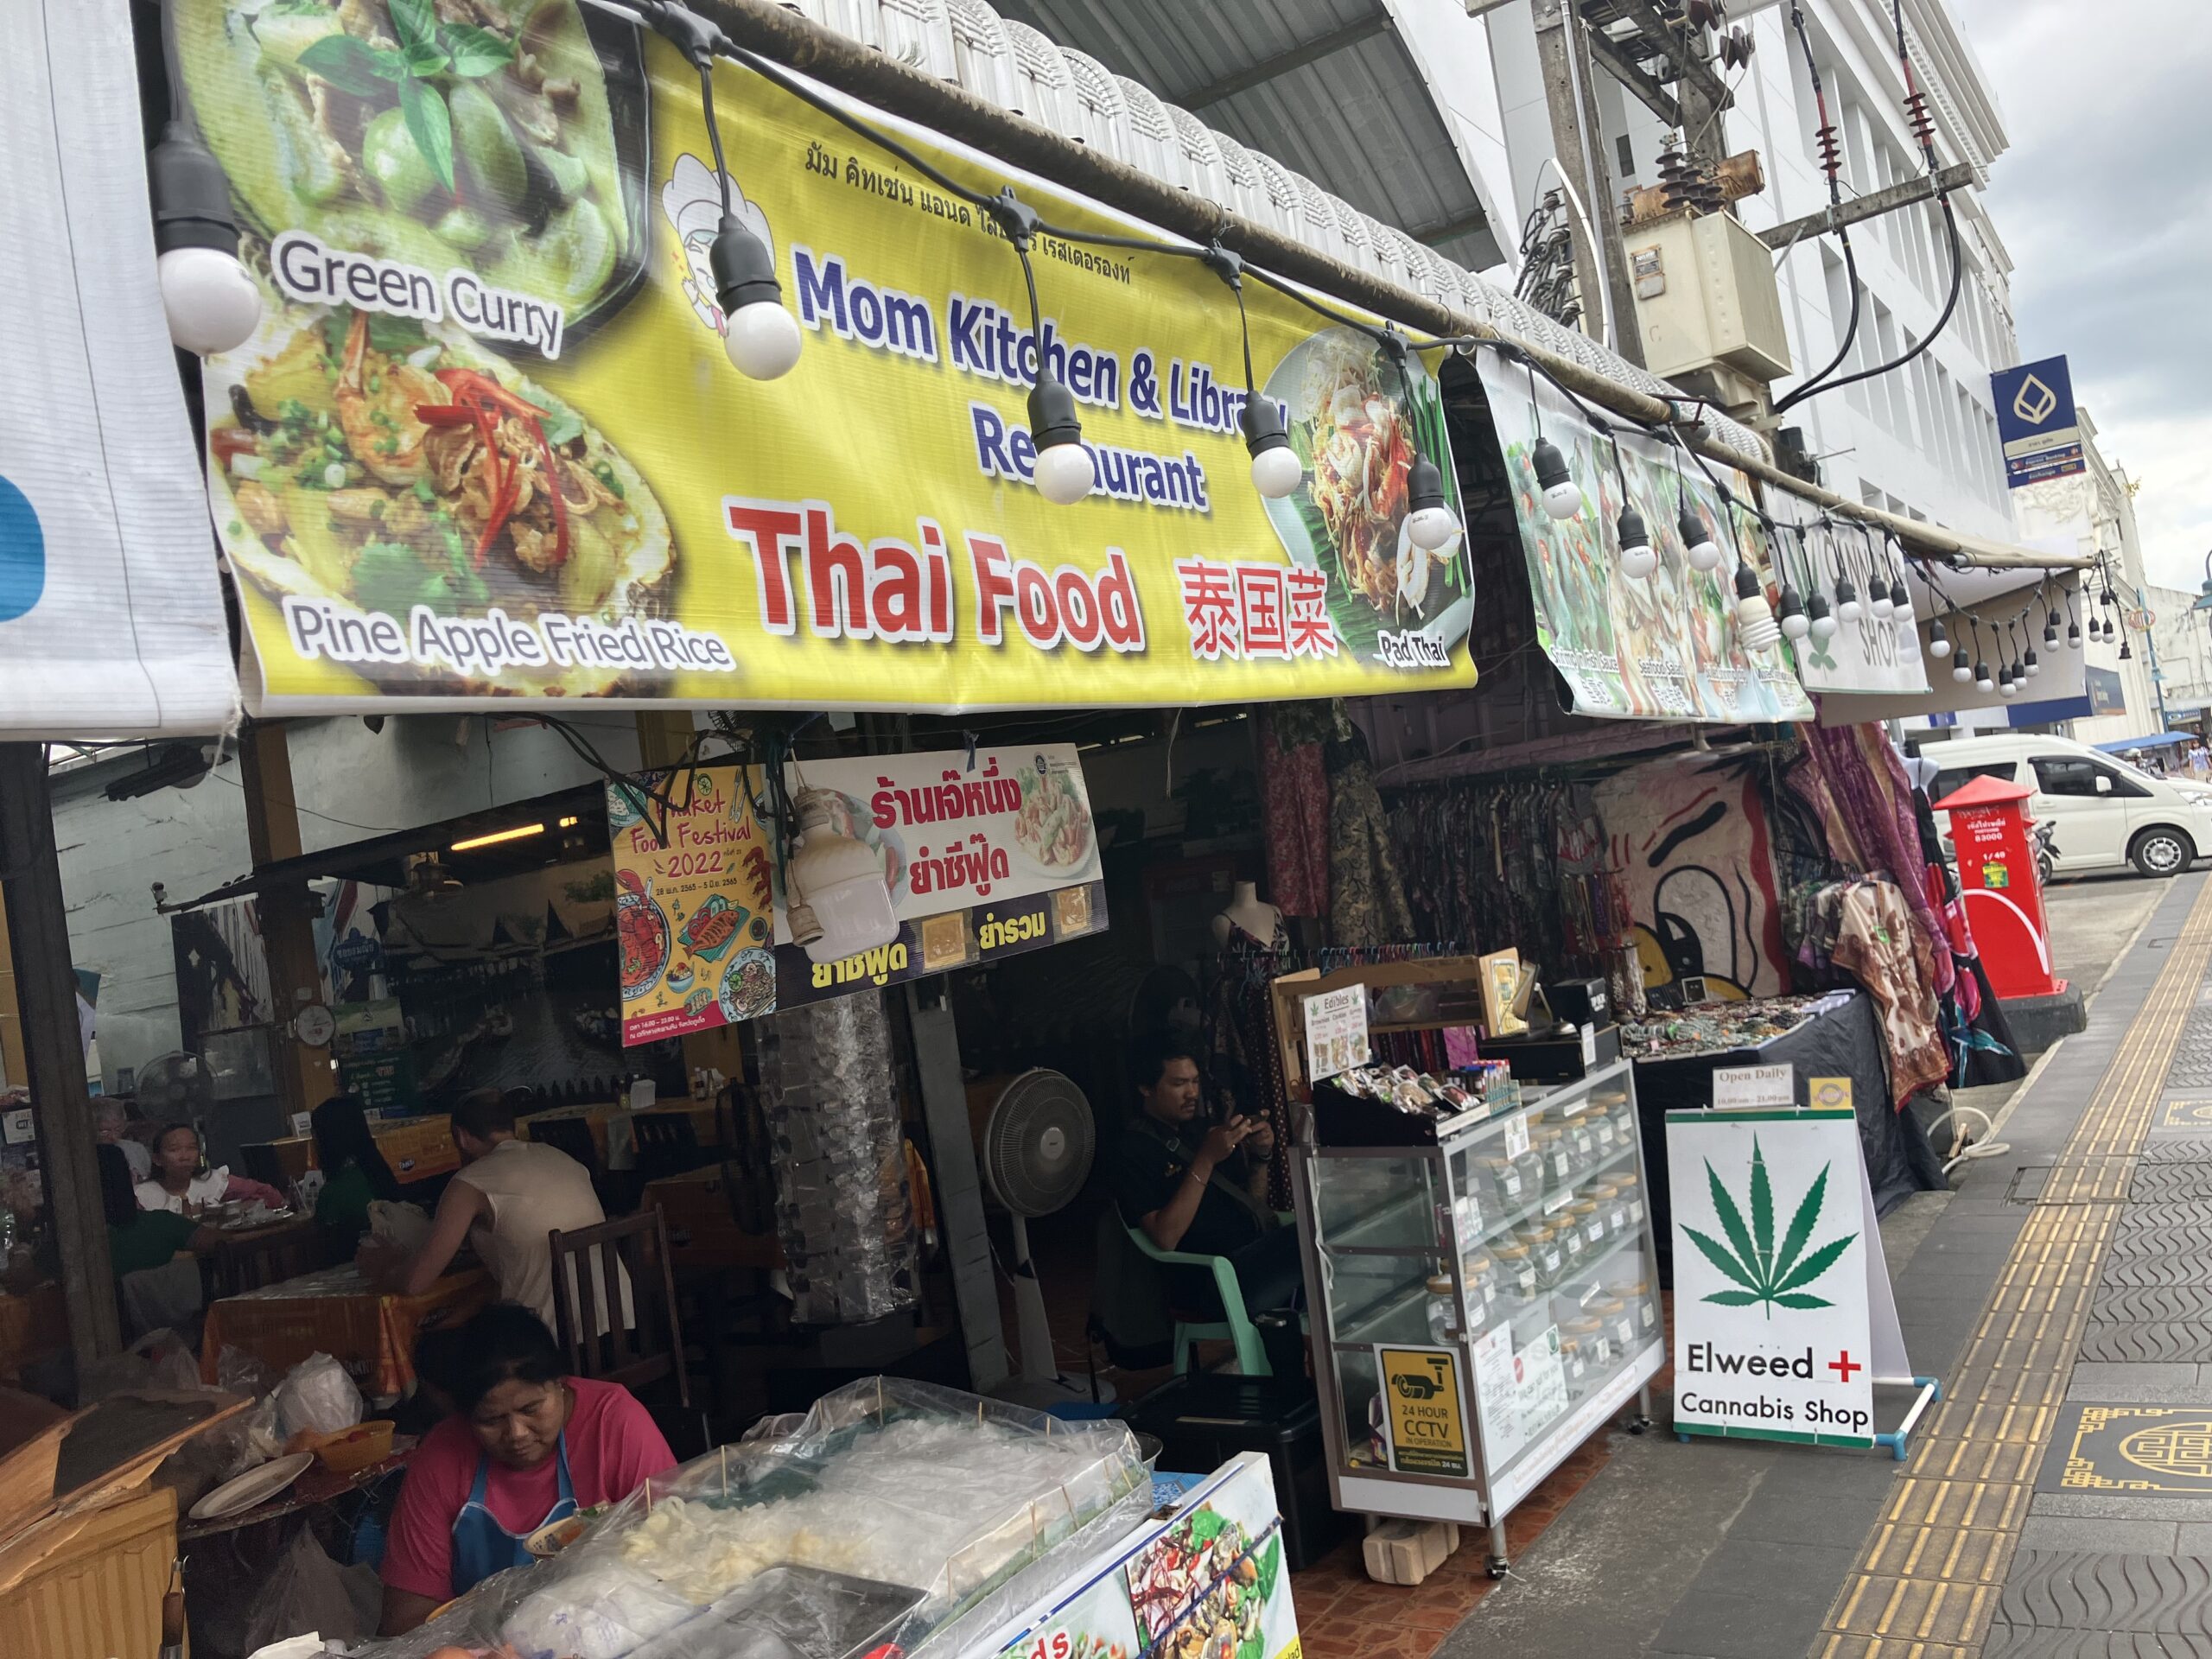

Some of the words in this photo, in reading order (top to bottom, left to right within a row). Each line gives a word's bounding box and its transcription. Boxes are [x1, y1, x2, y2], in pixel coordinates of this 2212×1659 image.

[804, 142, 838, 179] มัม
[845, 156, 913, 207] คิทเช่น
[1043, 236, 1135, 284] เรสเตอรองท์
[280, 240, 435, 314] Green
[450, 276, 557, 351] Curry
[795, 251, 933, 355] Mom
[951, 298, 1116, 403] Kitchen
[1130, 353, 1160, 413] &
[729, 505, 948, 632] Thai
[969, 537, 1141, 644] Food
[1179, 562, 1334, 653] 泰国菜
[292, 604, 401, 656] Pine
[419, 613, 542, 667] Apple
[544, 620, 646, 664] Fried
[652, 627, 729, 665] Rice
[1381, 636, 1412, 662] Pad
[1414, 635, 1446, 662] Thai
[1859, 617, 1898, 668] SHOP
[677, 816, 751, 849] Festival
[668, 850, 723, 878] 2022
[656, 887, 664, 896] 28
[681, 881, 696, 892] 2565
[722, 877, 737, 887] 2565
[980, 911, 1046, 949] ยำรวม
[1325, 994, 1349, 1010] Edibles
[1719, 1071, 1751, 1084] Open
[1755, 1068, 1787, 1081] Daily
[1688, 1341, 1814, 1379] Elweed
[1402, 1405, 1414, 1416] 24
[1418, 1406, 1448, 1419] HOUR
[1404, 1420, 1449, 1439] CCTV
[1681, 1392, 1794, 1420] Cannabis
[1805, 1399, 1868, 1433] Shop
[1414, 1438, 1452, 1448] OPERATION
